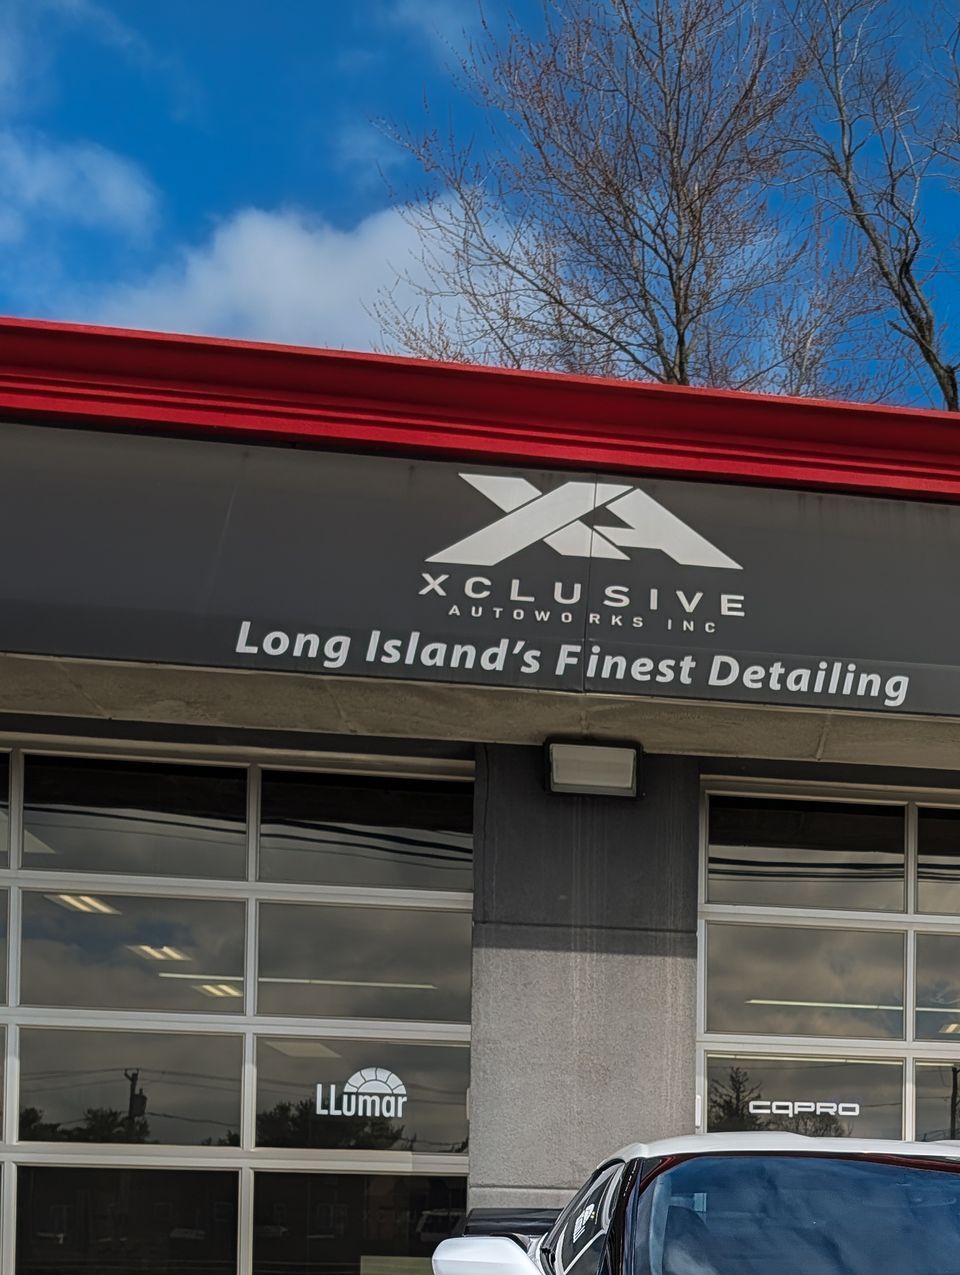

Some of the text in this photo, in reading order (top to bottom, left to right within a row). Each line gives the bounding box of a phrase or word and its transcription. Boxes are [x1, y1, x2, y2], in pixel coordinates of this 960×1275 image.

[418, 572, 745, 617] XCLUSIVE
[448, 604, 717, 634] AUTOWORKS INC
[235, 621, 350, 669] Long
[554, 643, 697, 687] Finest
[707, 655, 910, 706] Detailing
[316, 1083, 408, 1118] LLumar
